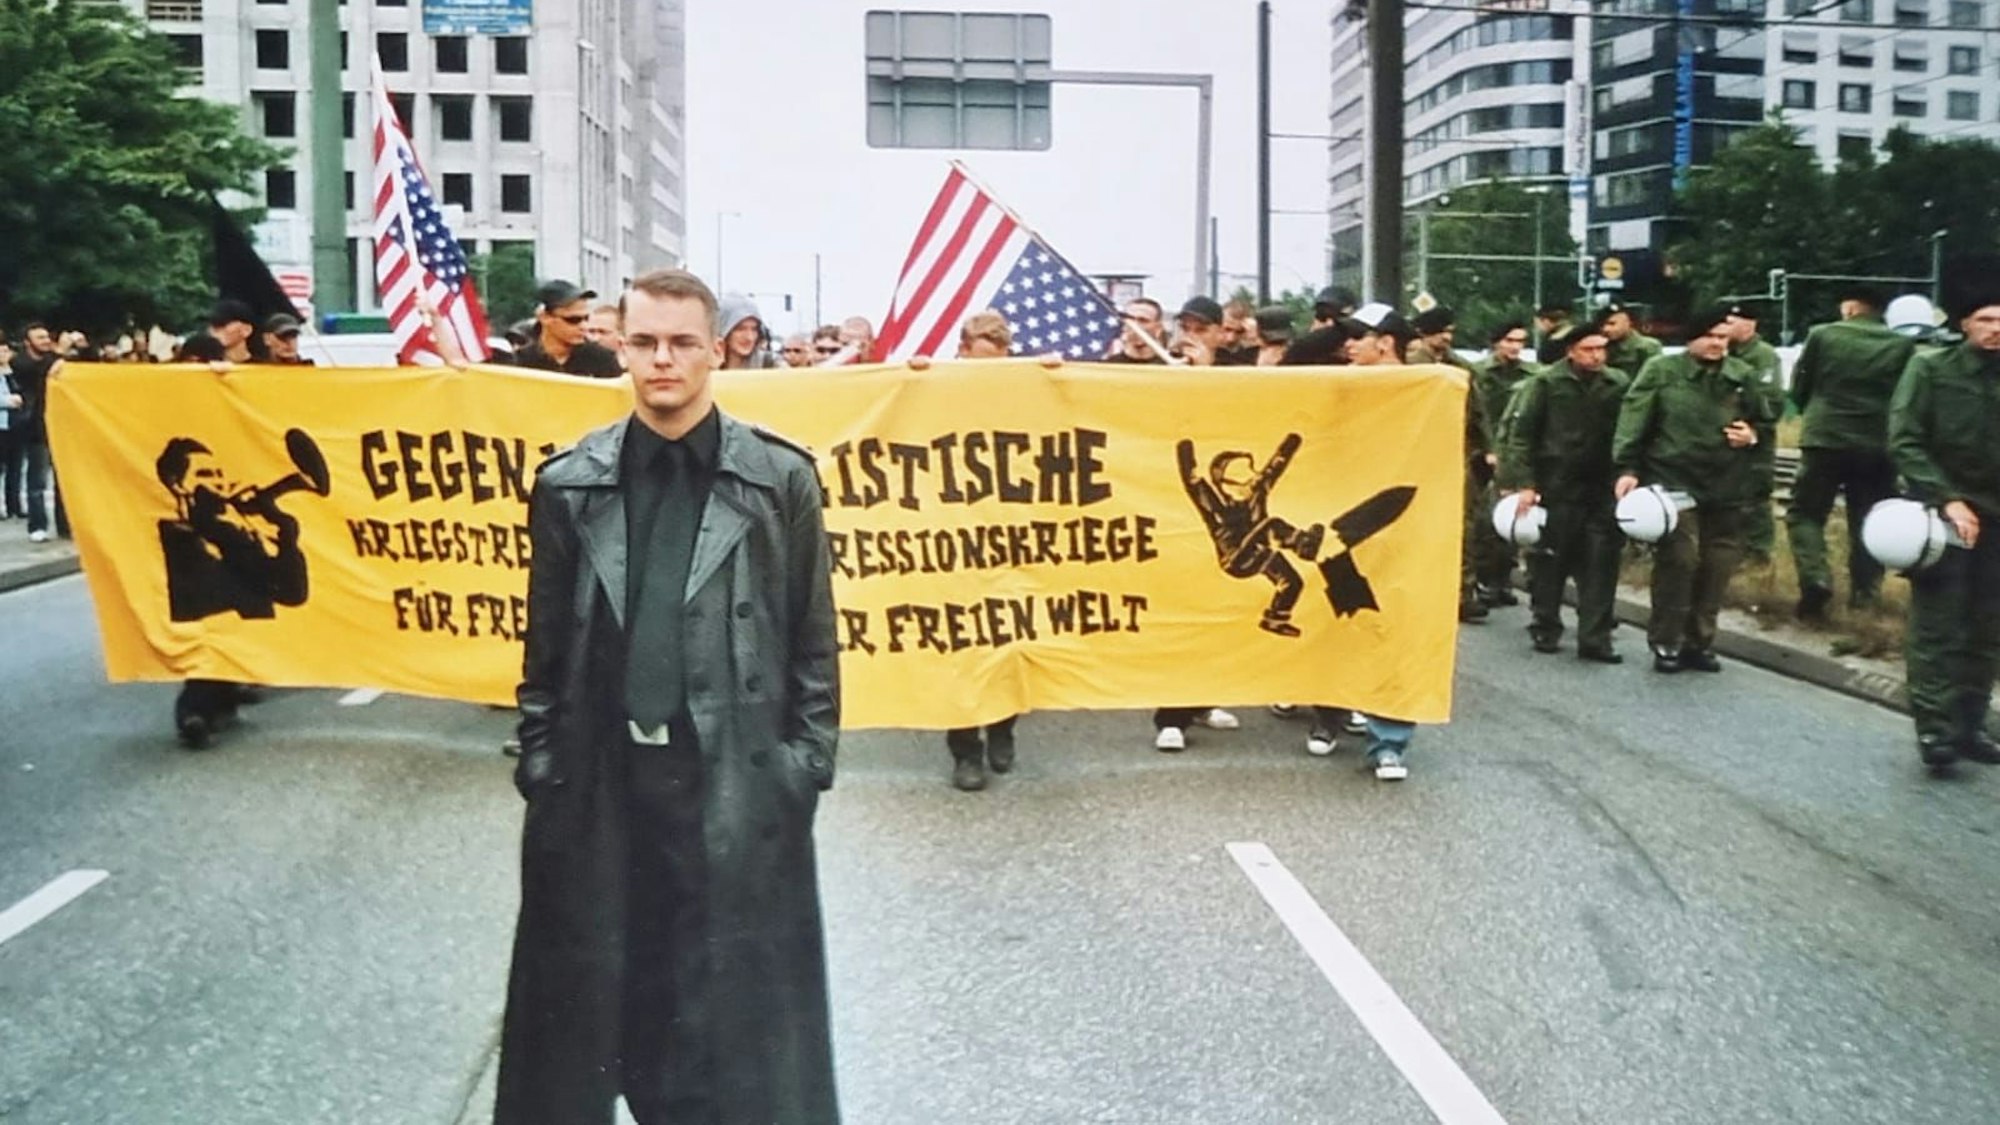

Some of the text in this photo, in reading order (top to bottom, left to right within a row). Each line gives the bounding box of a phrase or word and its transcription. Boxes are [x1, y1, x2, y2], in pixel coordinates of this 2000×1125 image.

[361, 427, 1112, 511] GEGEN ISTISCHE
[346, 515, 1159, 580] KRIEGSTRE RESSIONSKRIEGE
[466, 592, 529, 641] FRE
[836, 608, 876, 655] R
[886, 595, 1037, 655] FREIEN
[1046, 589, 1148, 636] WELT
